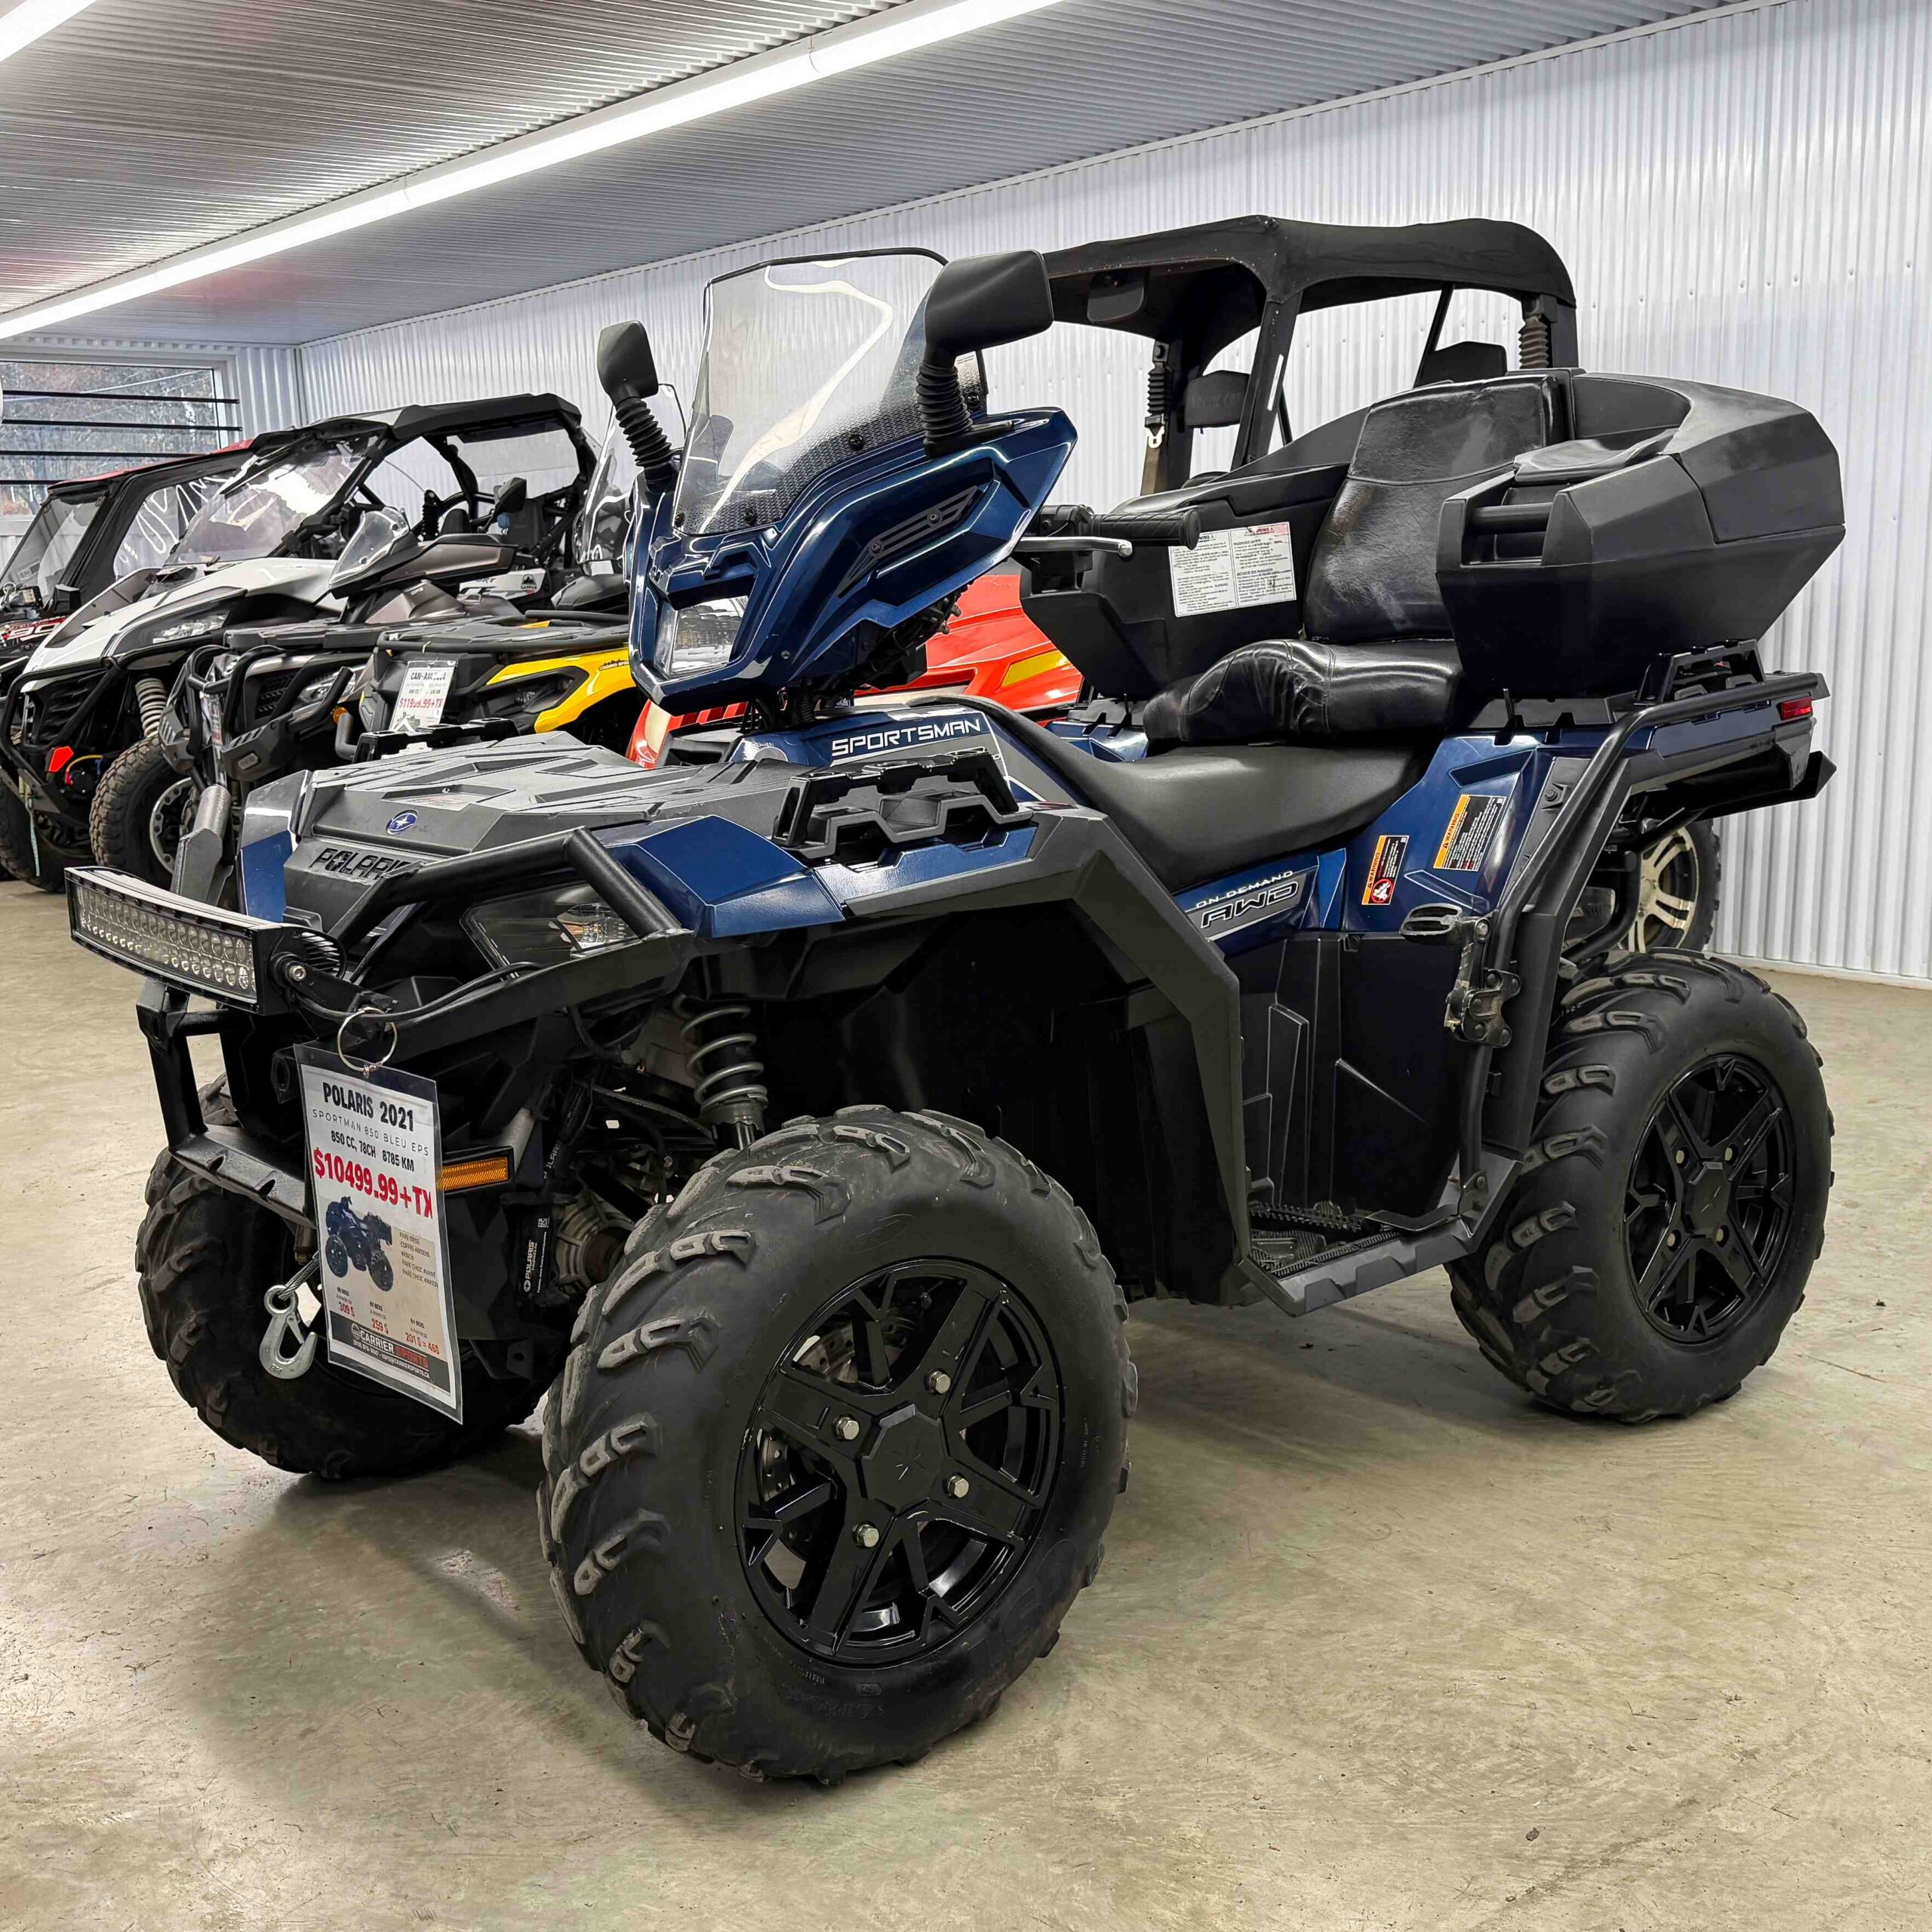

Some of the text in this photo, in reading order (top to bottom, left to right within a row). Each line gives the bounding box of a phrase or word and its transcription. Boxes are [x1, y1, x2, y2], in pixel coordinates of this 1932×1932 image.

[832, 719, 981, 756] SPORTSMAN
[1447, 812, 1460, 842] WARNING
[1370, 852, 1380, 882] WARNING
[1200, 881, 1299, 929] AWD
[322, 1081, 414, 1132] POLARIS 2021
[312, 1109, 429, 1157] SPORTMAN 850 BLEU EPS
[331, 1130, 415, 1172] 850 CC, 78CH 8785 KM
[313, 1146, 433, 1220] $10499.99+TX
[525, 1240, 534, 1279] POLARIS
[361, 1331, 394, 1353] CARRIER
[395, 1346, 429, 1368] SPORTS
